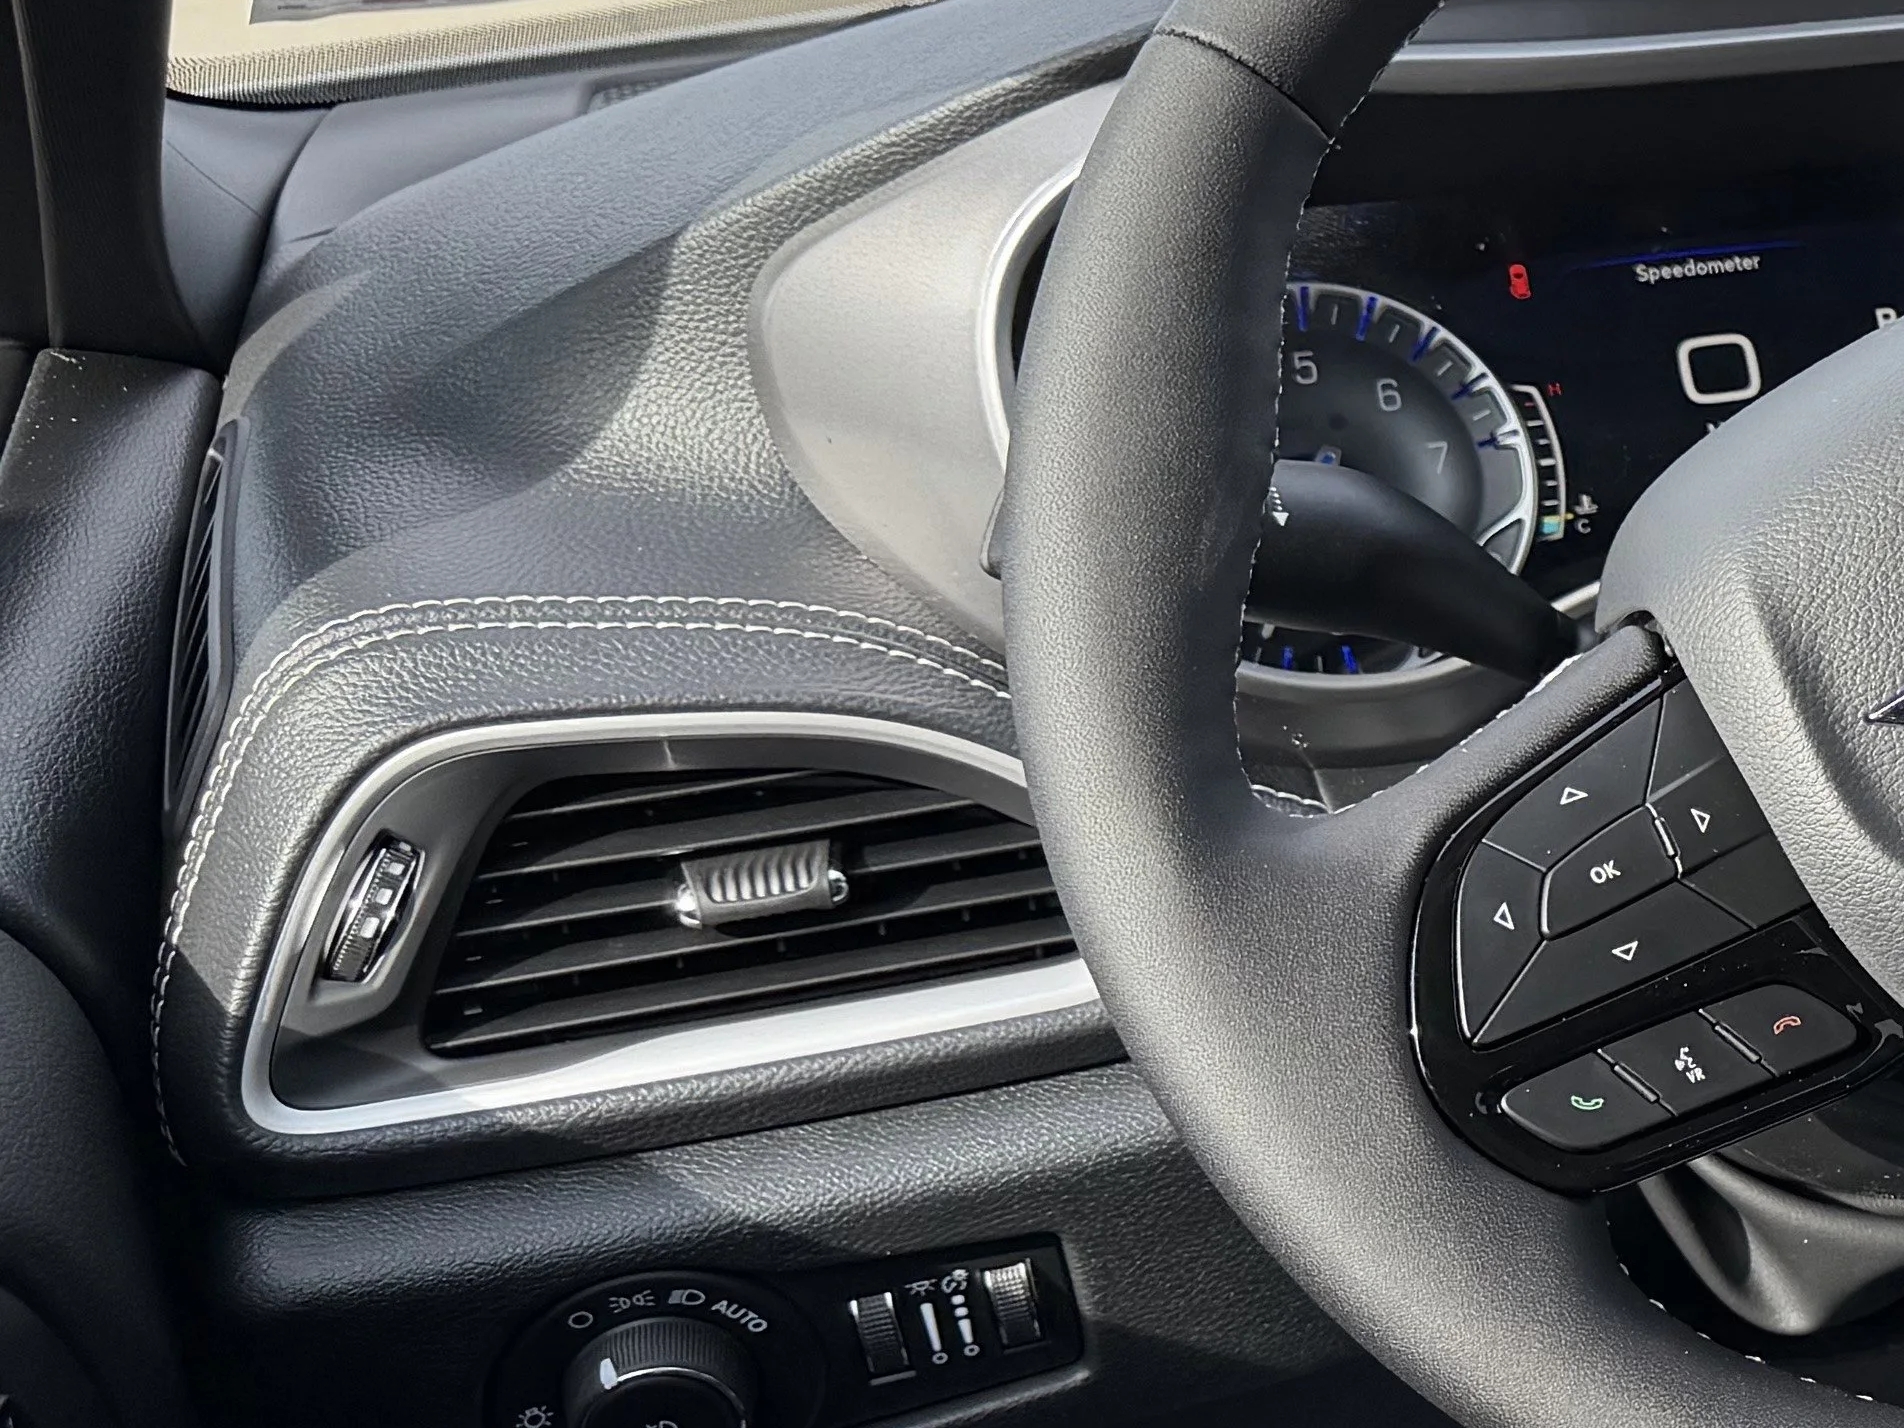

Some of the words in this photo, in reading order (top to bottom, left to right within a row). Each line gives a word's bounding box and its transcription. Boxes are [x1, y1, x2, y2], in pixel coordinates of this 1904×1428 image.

[1635, 253, 1761, 284] Speedometer
[1293, 351, 1318, 385] 5
[1376, 378, 1401, 411] 6
[1427, 441, 1448, 473] 7
[1590, 859, 1621, 884] OK
[711, 1300, 768, 1334] AUTO
